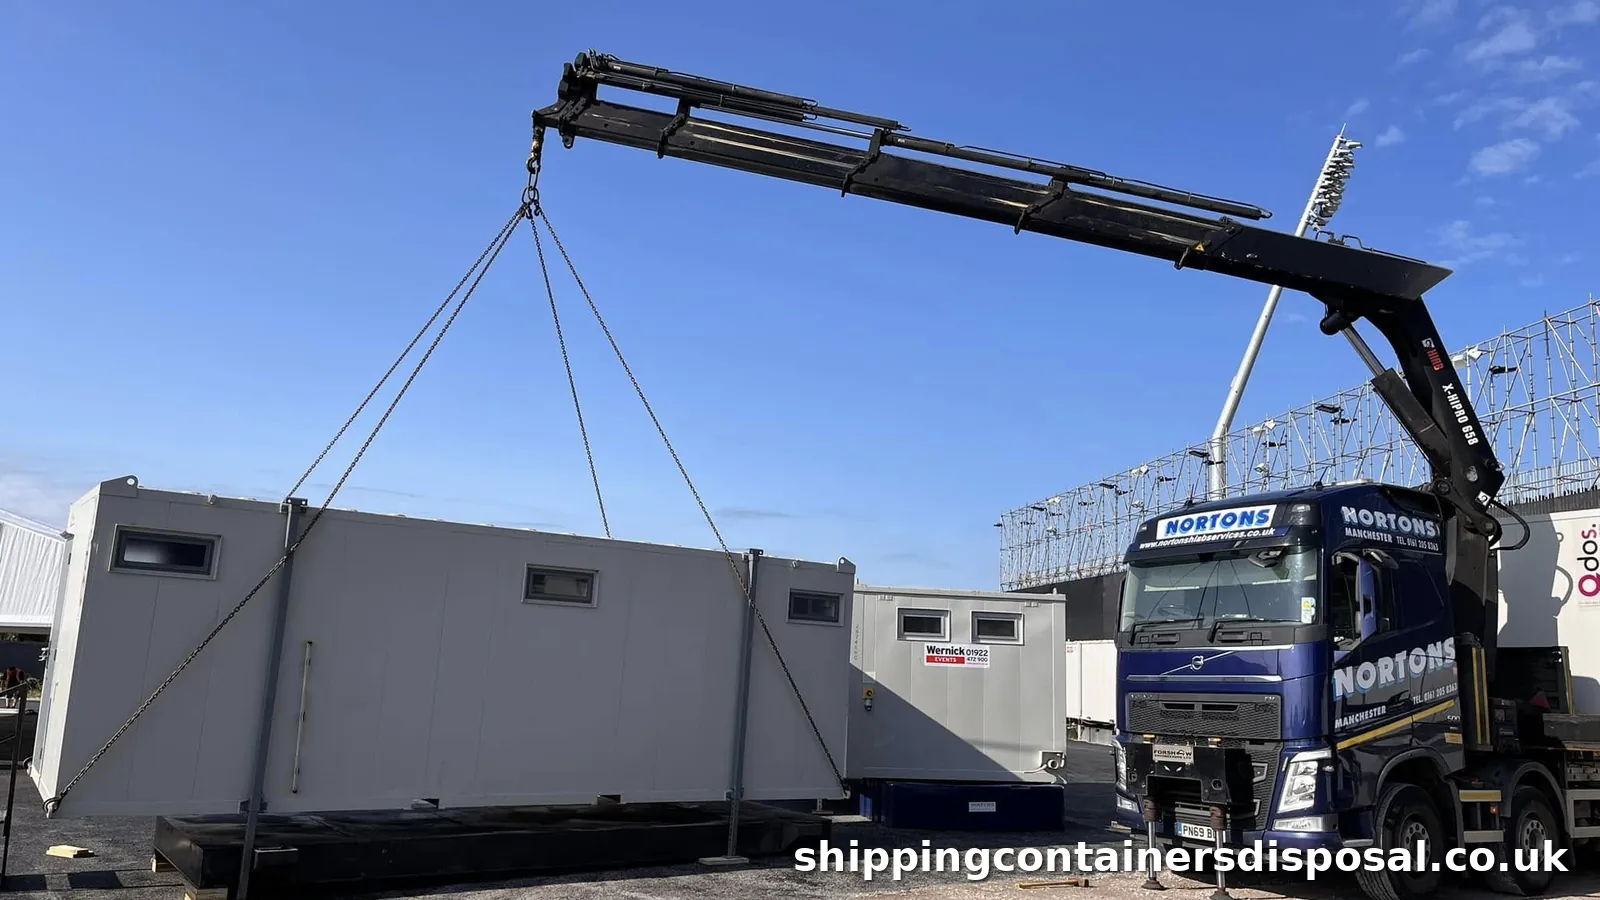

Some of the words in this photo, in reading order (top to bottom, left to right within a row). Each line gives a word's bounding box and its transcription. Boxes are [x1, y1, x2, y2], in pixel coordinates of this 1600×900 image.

[1442, 382, 1469, 424] X-HIPRO
[1461, 424, 1478, 445] 658
[1165, 508, 1271, 536] NORTONS
[1340, 505, 1436, 538] NORTONS
[1345, 527, 1393, 543] MANCHESTER
[926, 645, 965, 656] Wernick
[965, 649, 989, 657] 01922
[1333, 637, 1456, 701] NORTONS
[1423, 690, 1435, 701] 0161
[1436, 686, 1445, 697] 205
[1446, 682, 1458, 694] 8363
[1335, 706, 1387, 728] MANCHESTER
[1183, 825, 1204, 837] PN69
